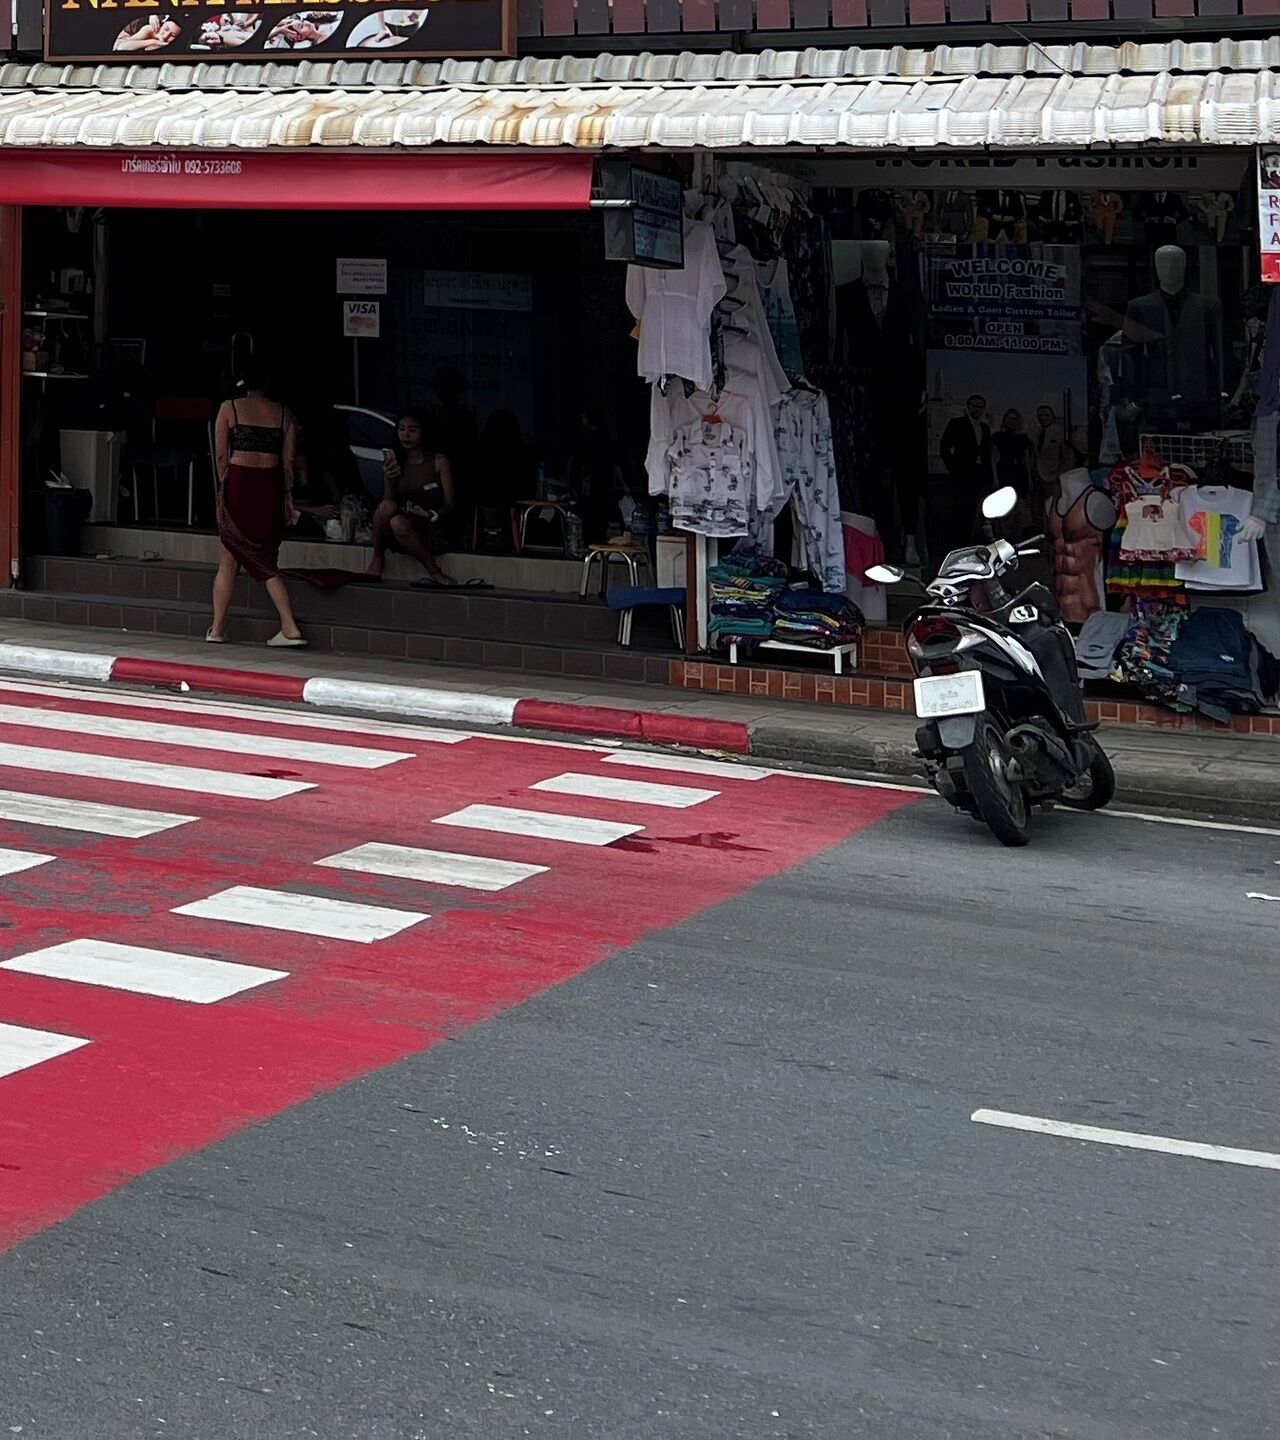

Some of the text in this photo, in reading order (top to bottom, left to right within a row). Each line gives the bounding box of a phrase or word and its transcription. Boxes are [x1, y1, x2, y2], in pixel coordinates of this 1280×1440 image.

[951, 259, 1059, 280] WELCOME
[946, 283, 1064, 300] WORLD Fashion
[348, 303, 377, 315] VISA
[986, 323, 1023, 334] OPEN
